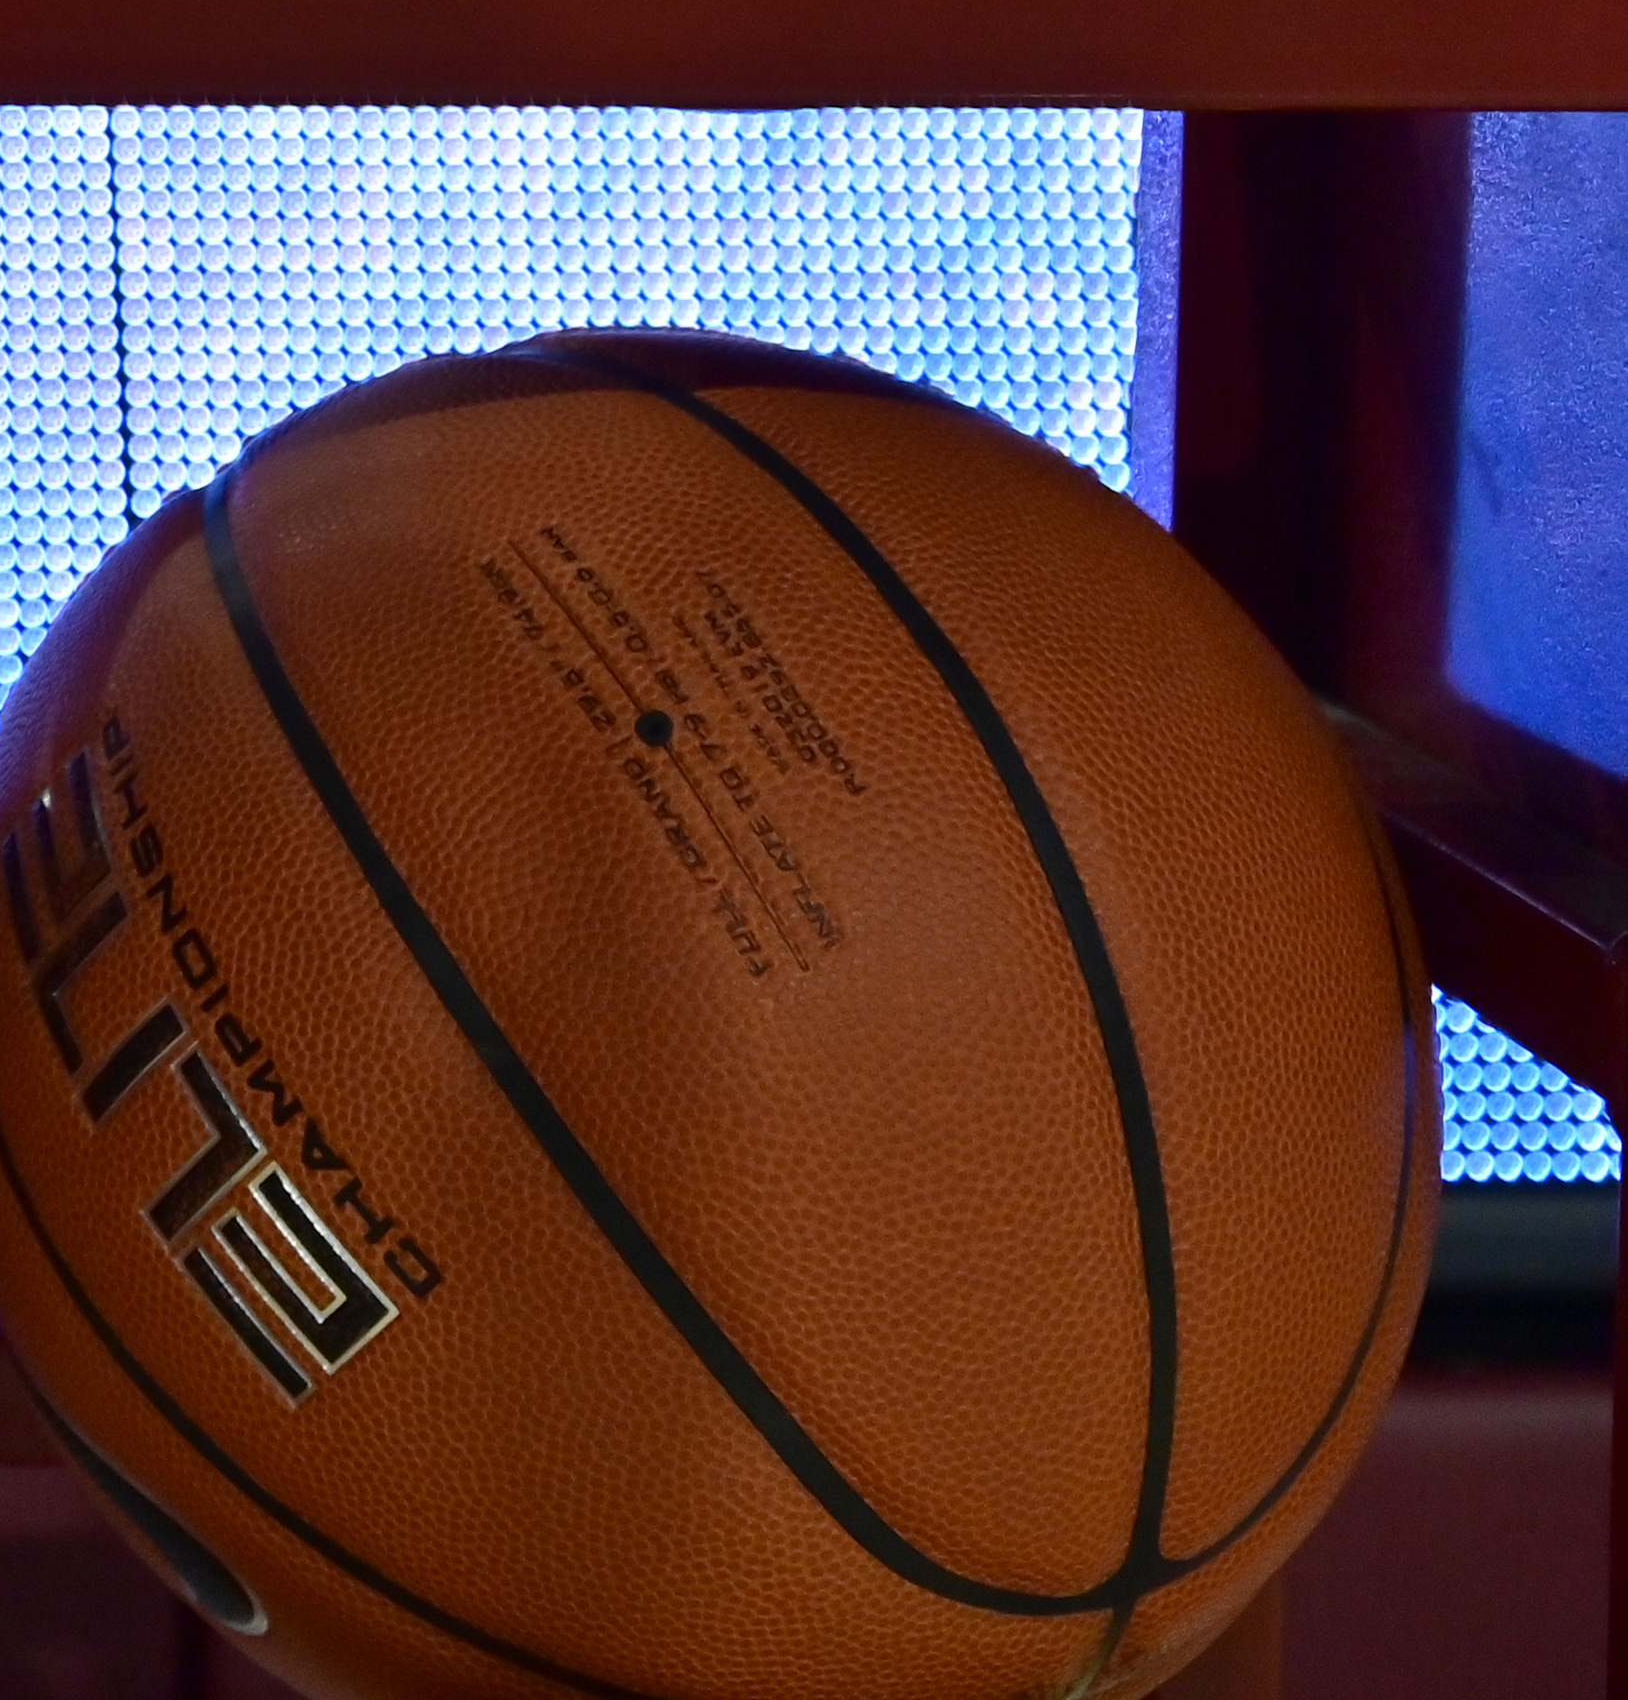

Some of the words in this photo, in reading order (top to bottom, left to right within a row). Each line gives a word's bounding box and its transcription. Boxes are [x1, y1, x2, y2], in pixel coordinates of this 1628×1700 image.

[621, 757, 707, 873] GRAND
[716, 764, 757, 812] TO
[714, 890, 769, 977] FULL
[746, 813, 842, 951] INFLATE
[100, 716, 444, 1300] CHAMPIONSHIP
[2, 748, 400, 1412] ELITE
